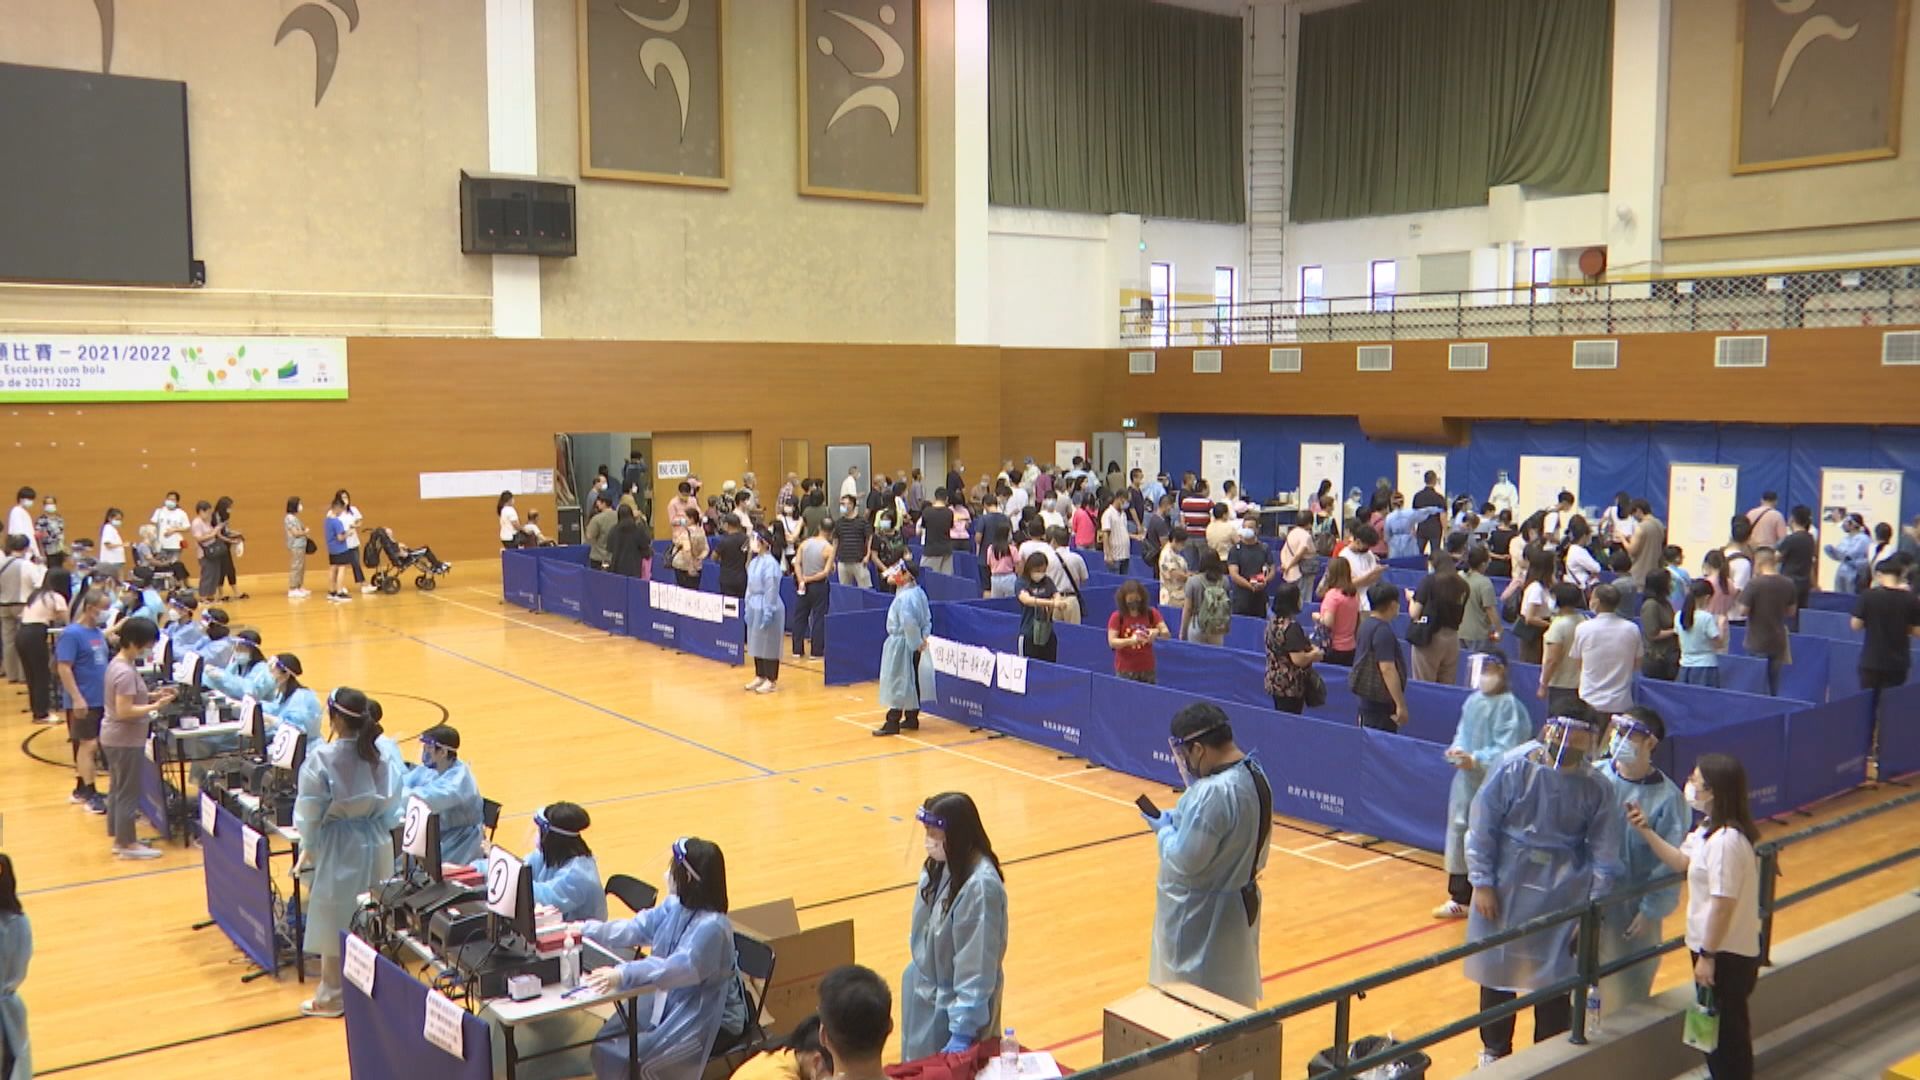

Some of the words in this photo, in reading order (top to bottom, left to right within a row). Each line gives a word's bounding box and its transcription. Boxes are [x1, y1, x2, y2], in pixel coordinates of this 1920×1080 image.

[78, 345, 171, 361] 2021/2022
[4, 364, 55, 375] Escolares
[58, 366, 79, 375] com
[82, 364, 106, 375] bola
[8, 377, 21, 387] de
